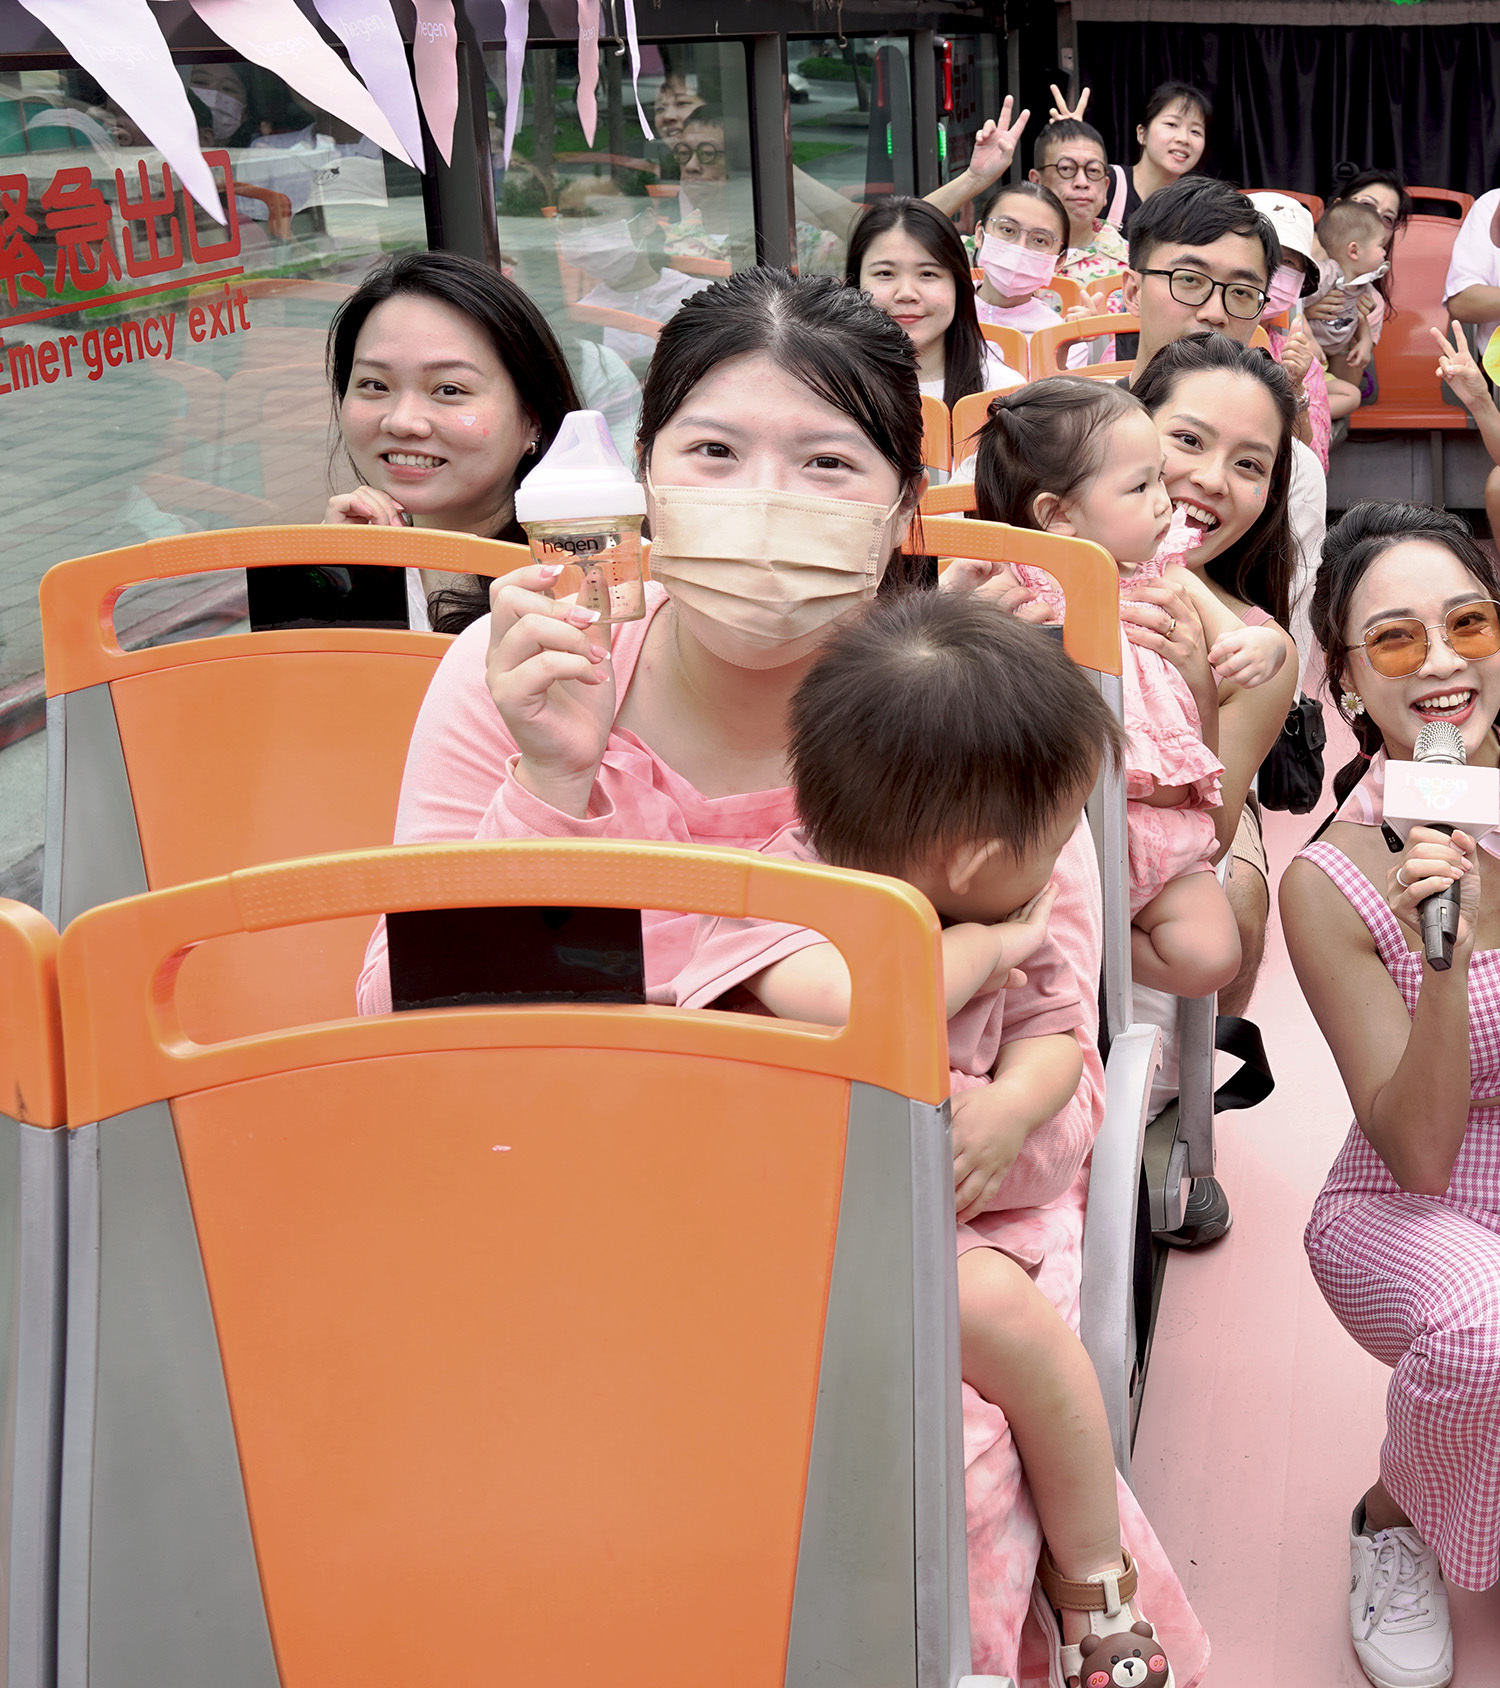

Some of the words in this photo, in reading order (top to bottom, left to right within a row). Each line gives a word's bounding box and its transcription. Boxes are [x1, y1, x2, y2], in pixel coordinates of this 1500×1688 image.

[340, 13, 386, 42] hegen
[417, 16, 448, 44] hegen
[82, 39, 156, 70] hegen
[248, 35, 313, 60] hegen
[188, 282, 251, 343] exit
[542, 538, 599, 557] hegen
[1405, 771, 1469, 793] hegen
